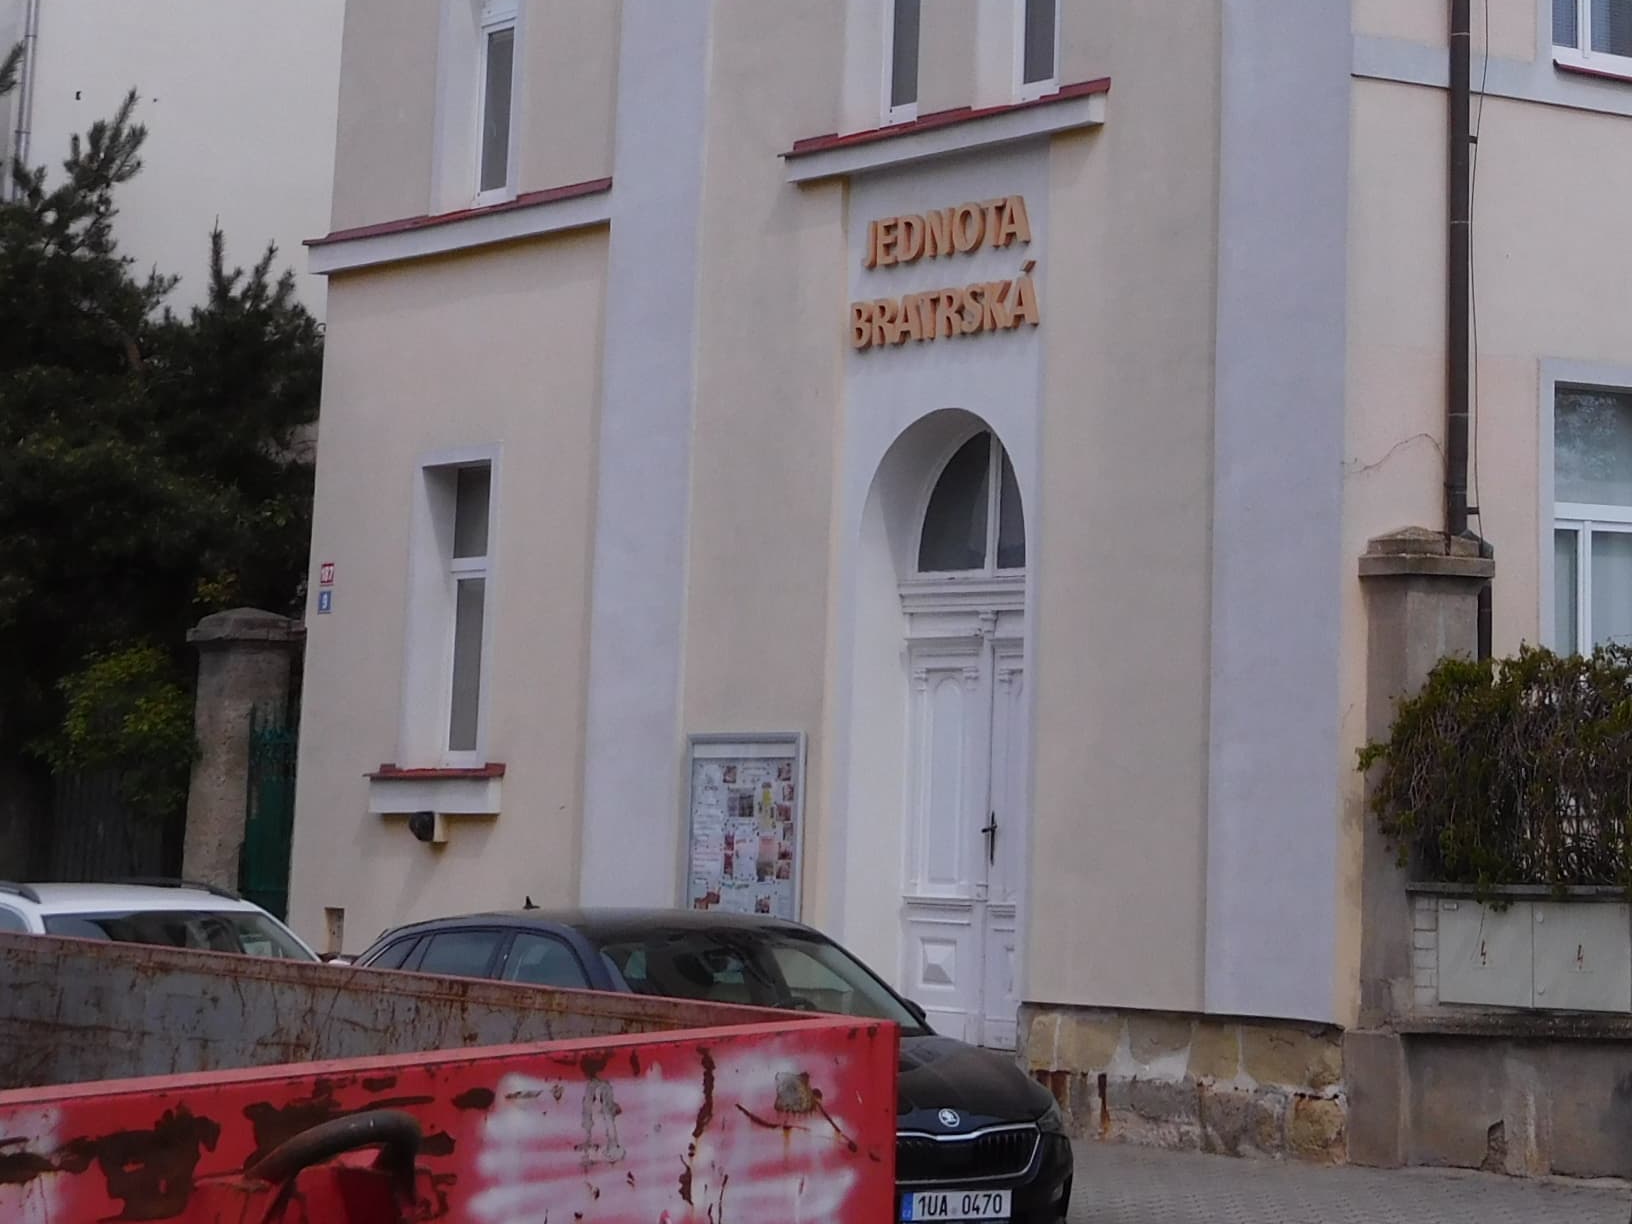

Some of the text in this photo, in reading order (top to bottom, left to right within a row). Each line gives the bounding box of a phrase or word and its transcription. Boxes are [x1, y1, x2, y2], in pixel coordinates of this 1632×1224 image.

[863, 195, 1031, 269] JEDNOTA
[851, 260, 1040, 348] BRATRSKÁ
[918, 1193, 1002, 1217] 1UA 0470
